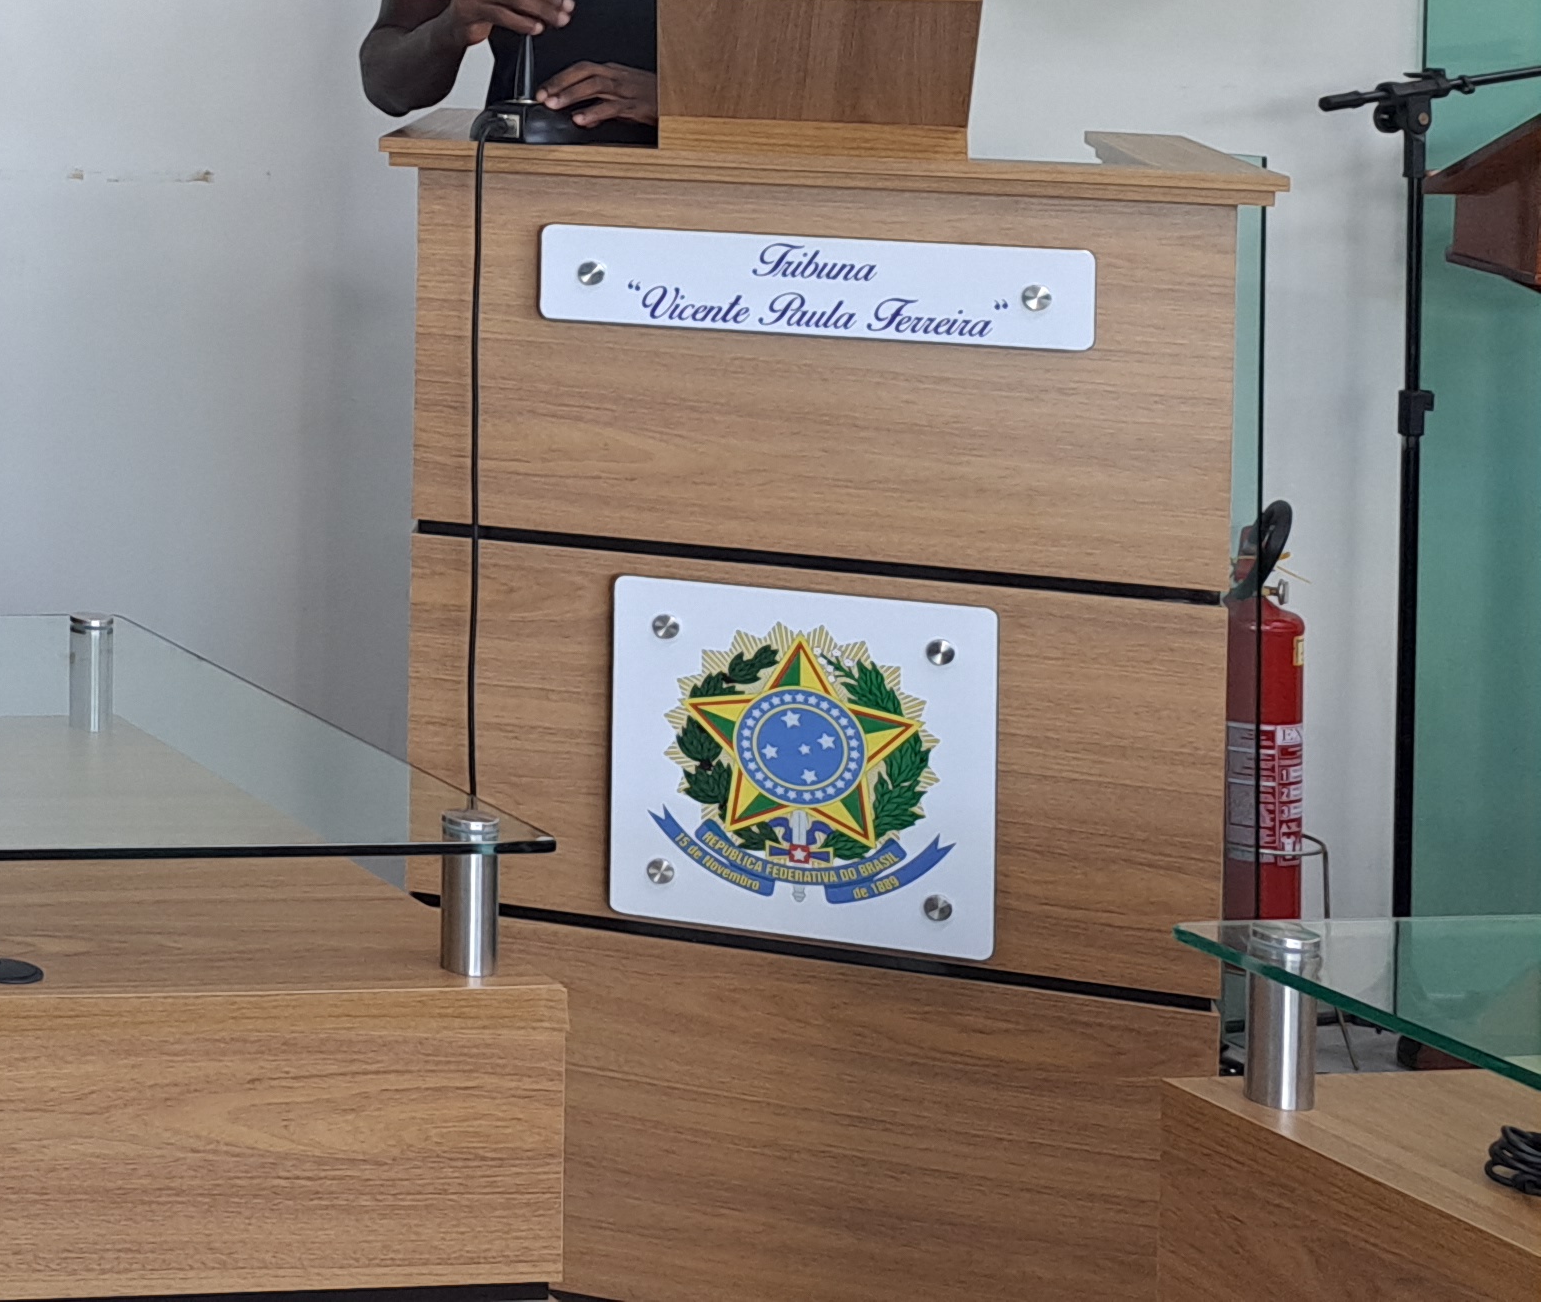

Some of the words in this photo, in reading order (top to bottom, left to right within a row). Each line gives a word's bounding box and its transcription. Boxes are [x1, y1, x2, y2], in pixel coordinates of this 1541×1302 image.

[751, 242, 879, 282] Tribuna
[757, 292, 857, 331] Paula
[675, 832, 691, 847] 15
[687, 845, 703, 859] de
[701, 856, 760, 891] Novembro
[852, 887, 869, 899] de
[765, 862, 838, 883] FEDERATIVA
[839, 867, 857, 881] DO
[858, 851, 899, 876] BRASIL
